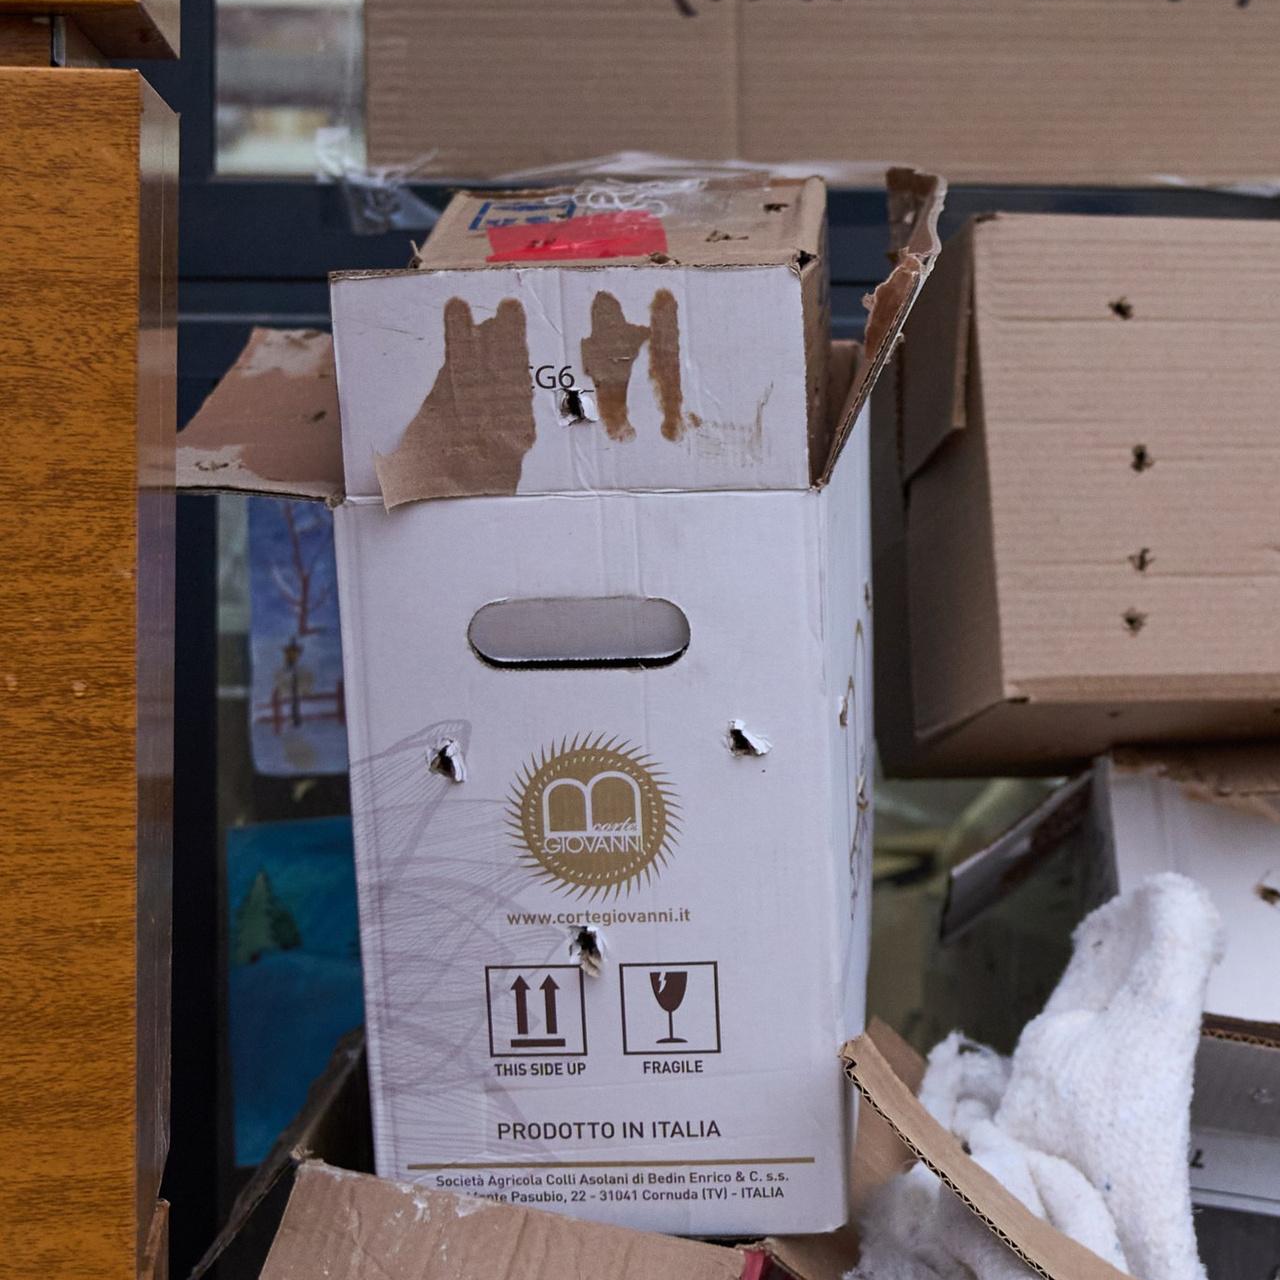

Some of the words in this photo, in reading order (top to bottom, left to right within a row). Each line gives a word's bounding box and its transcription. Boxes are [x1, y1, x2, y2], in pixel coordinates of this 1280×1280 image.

[507, 908, 691, 927] www.cortegiovanni.it
[494, 1062, 528, 1077] THIS
[530, 1062, 564, 1076] SIDE
[566, 1061, 587, 1076] UP
[642, 1060, 704, 1074] FRAGILE
[497, 1121, 615, 1140] PRODOTTO
[622, 1121, 645, 1139] IN
[652, 1120, 722, 1139] ITALIA
[436, 1172, 485, 1188] Società
[488, 1173, 543, 1189] Agricola
[546, 1172, 577, 1186] Colli
[579, 1172, 629, 1186] Asolani
[632, 1171, 645, 1185] di
[648, 1171, 686, 1185] Bedin
[689, 1170, 732, 1184] Enrico
[735, 1170, 746, 1183] &
[749, 1170, 763, 1182] C.
[511, 1190, 568, 1205] Pasubio,
[571, 1189, 587, 1202] 22
[599, 1188, 639, 1202] 31041
[642, 1187, 699, 1202] Cornuda
[702, 1186, 728, 1201] (TV)
[741, 1185, 785, 1199] ITALIA
